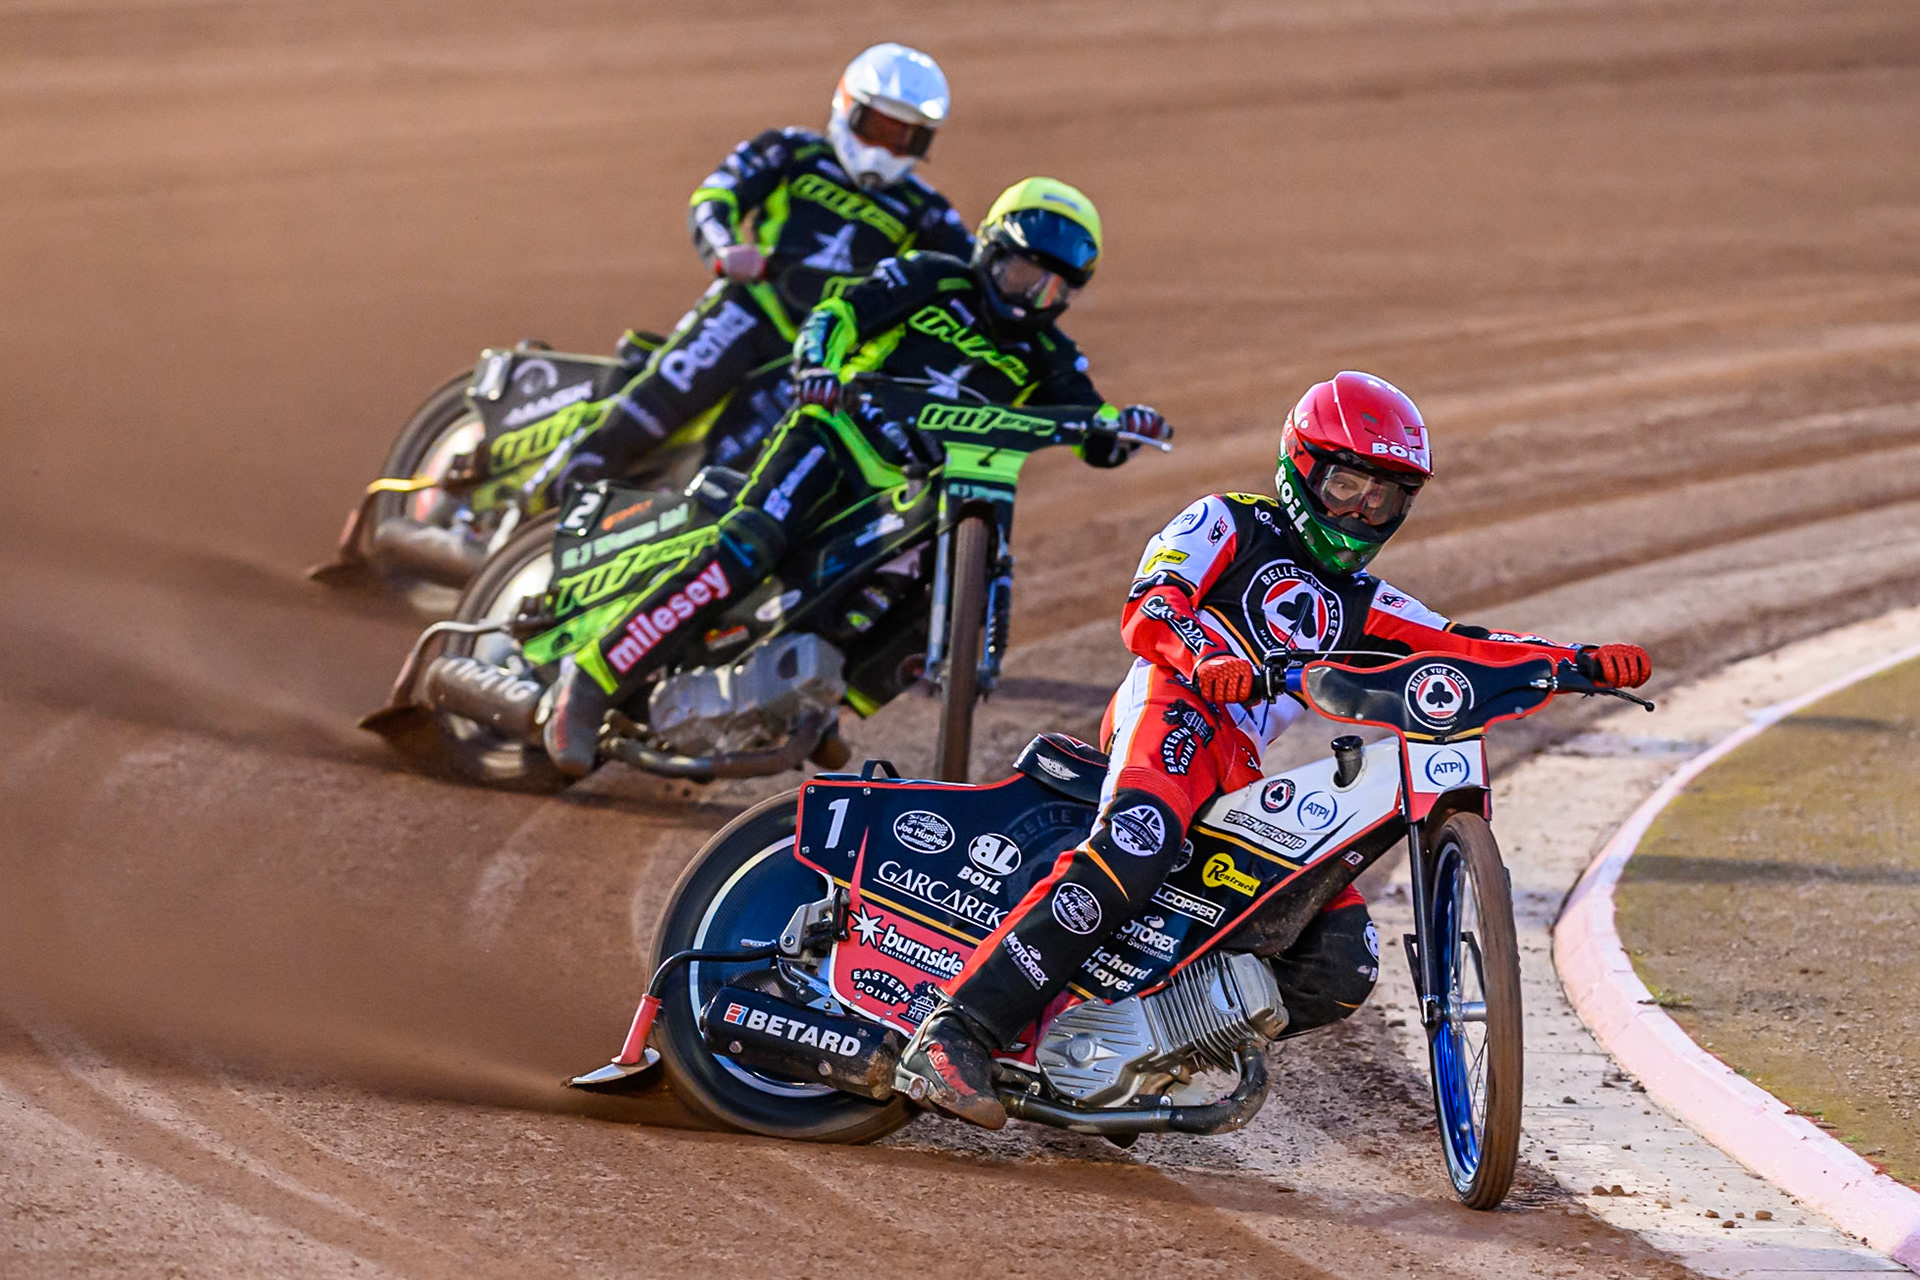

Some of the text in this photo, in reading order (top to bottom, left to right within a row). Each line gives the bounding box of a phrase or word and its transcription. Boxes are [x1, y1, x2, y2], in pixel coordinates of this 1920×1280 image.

[564, 492, 600, 529] 2
[607, 561, 731, 675] milesey
[1260, 566, 1299, 586] BELLE
[1327, 600, 1338, 637] ACES
[1409, 667, 1468, 692] BELLE VUE ACES
[1163, 727, 1192, 773] EASTERN
[1178, 738, 1197, 774] POINT
[1433, 761, 1463, 775] ATPI
[824, 797, 850, 849] 1
[1303, 801, 1331, 820] ATPI
[896, 822, 948, 847] Joe Hughes
[1226, 811, 1306, 850] PREMIERSHIP
[957, 865, 1002, 895] BOLL
[1206, 858, 1255, 892] Rentruck
[878, 860, 1009, 929] GARCAREK
[1066, 901, 1090, 931] Hughes
[879, 945, 916, 965] chartered
[881, 925, 963, 976] burnside
[1006, 931, 1049, 987] MOTOREX
[1092, 945, 1153, 981] ichard
[1127, 937, 1173, 963] Switzerland
[853, 970, 912, 1002] EASTERN
[856, 981, 900, 1005] POINT
[1080, 957, 1135, 993] Hayes
[746, 1008, 861, 1057] BETARD
